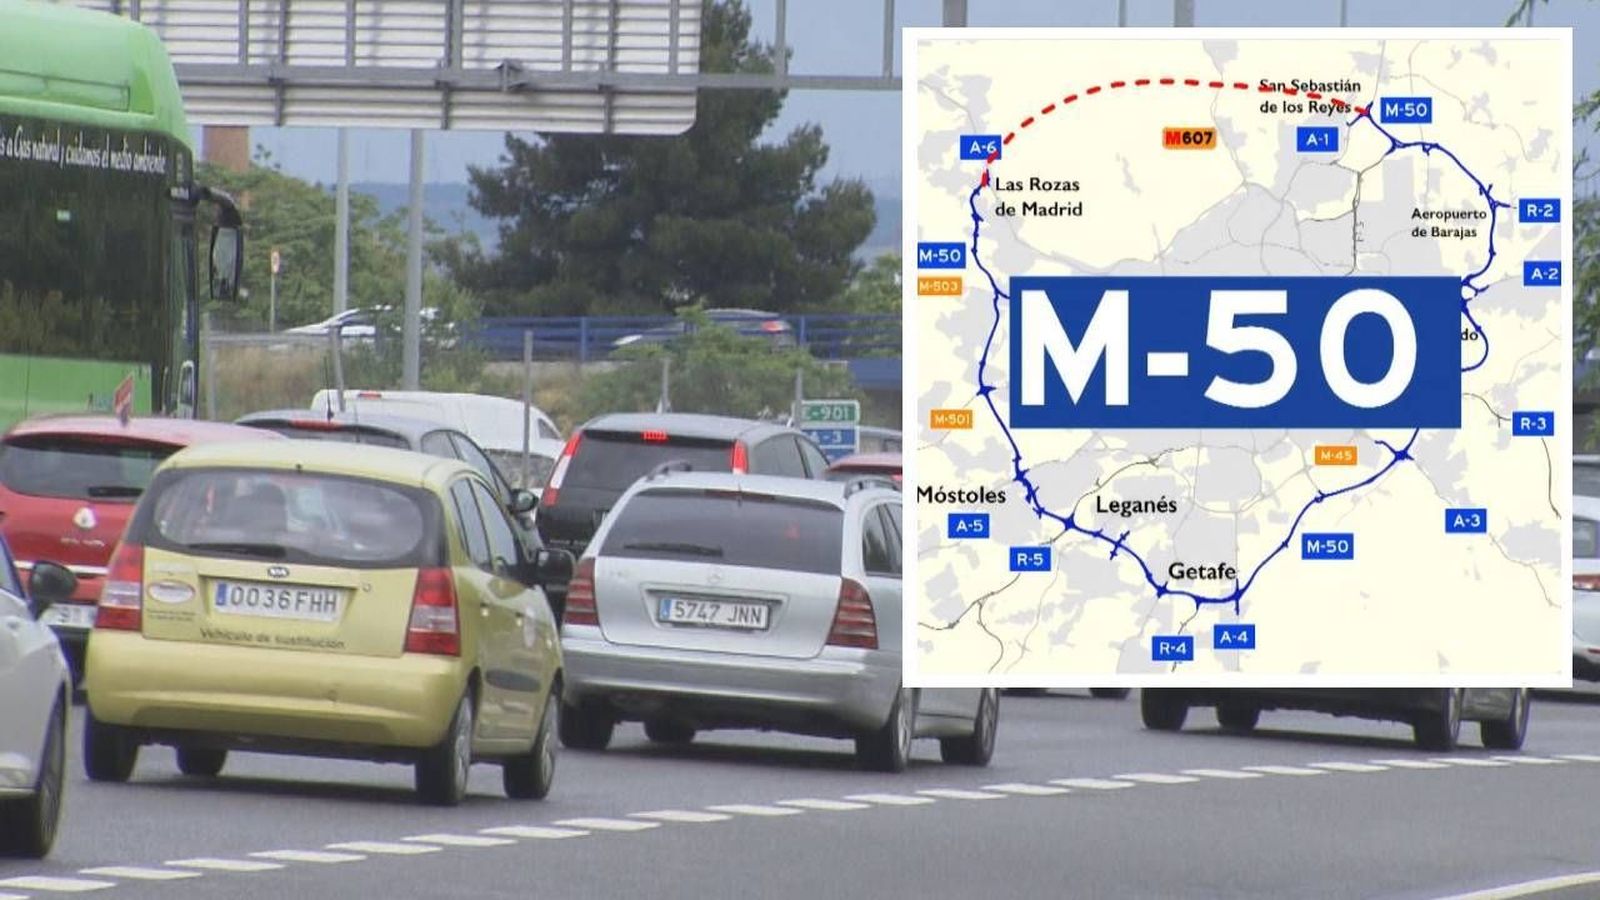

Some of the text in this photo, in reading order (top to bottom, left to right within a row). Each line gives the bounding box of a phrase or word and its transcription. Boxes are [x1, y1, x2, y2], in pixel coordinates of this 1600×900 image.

[32, 128, 60, 163] natural
[66, 131, 100, 168] cuidamos
[101, 133, 110, 169] el
[111, 136, 131, 171] medio
[133, 137, 166, 174] ambiente
[231, 586, 338, 613] 0036 FHH
[675, 601, 762, 624] 5747 JNN
